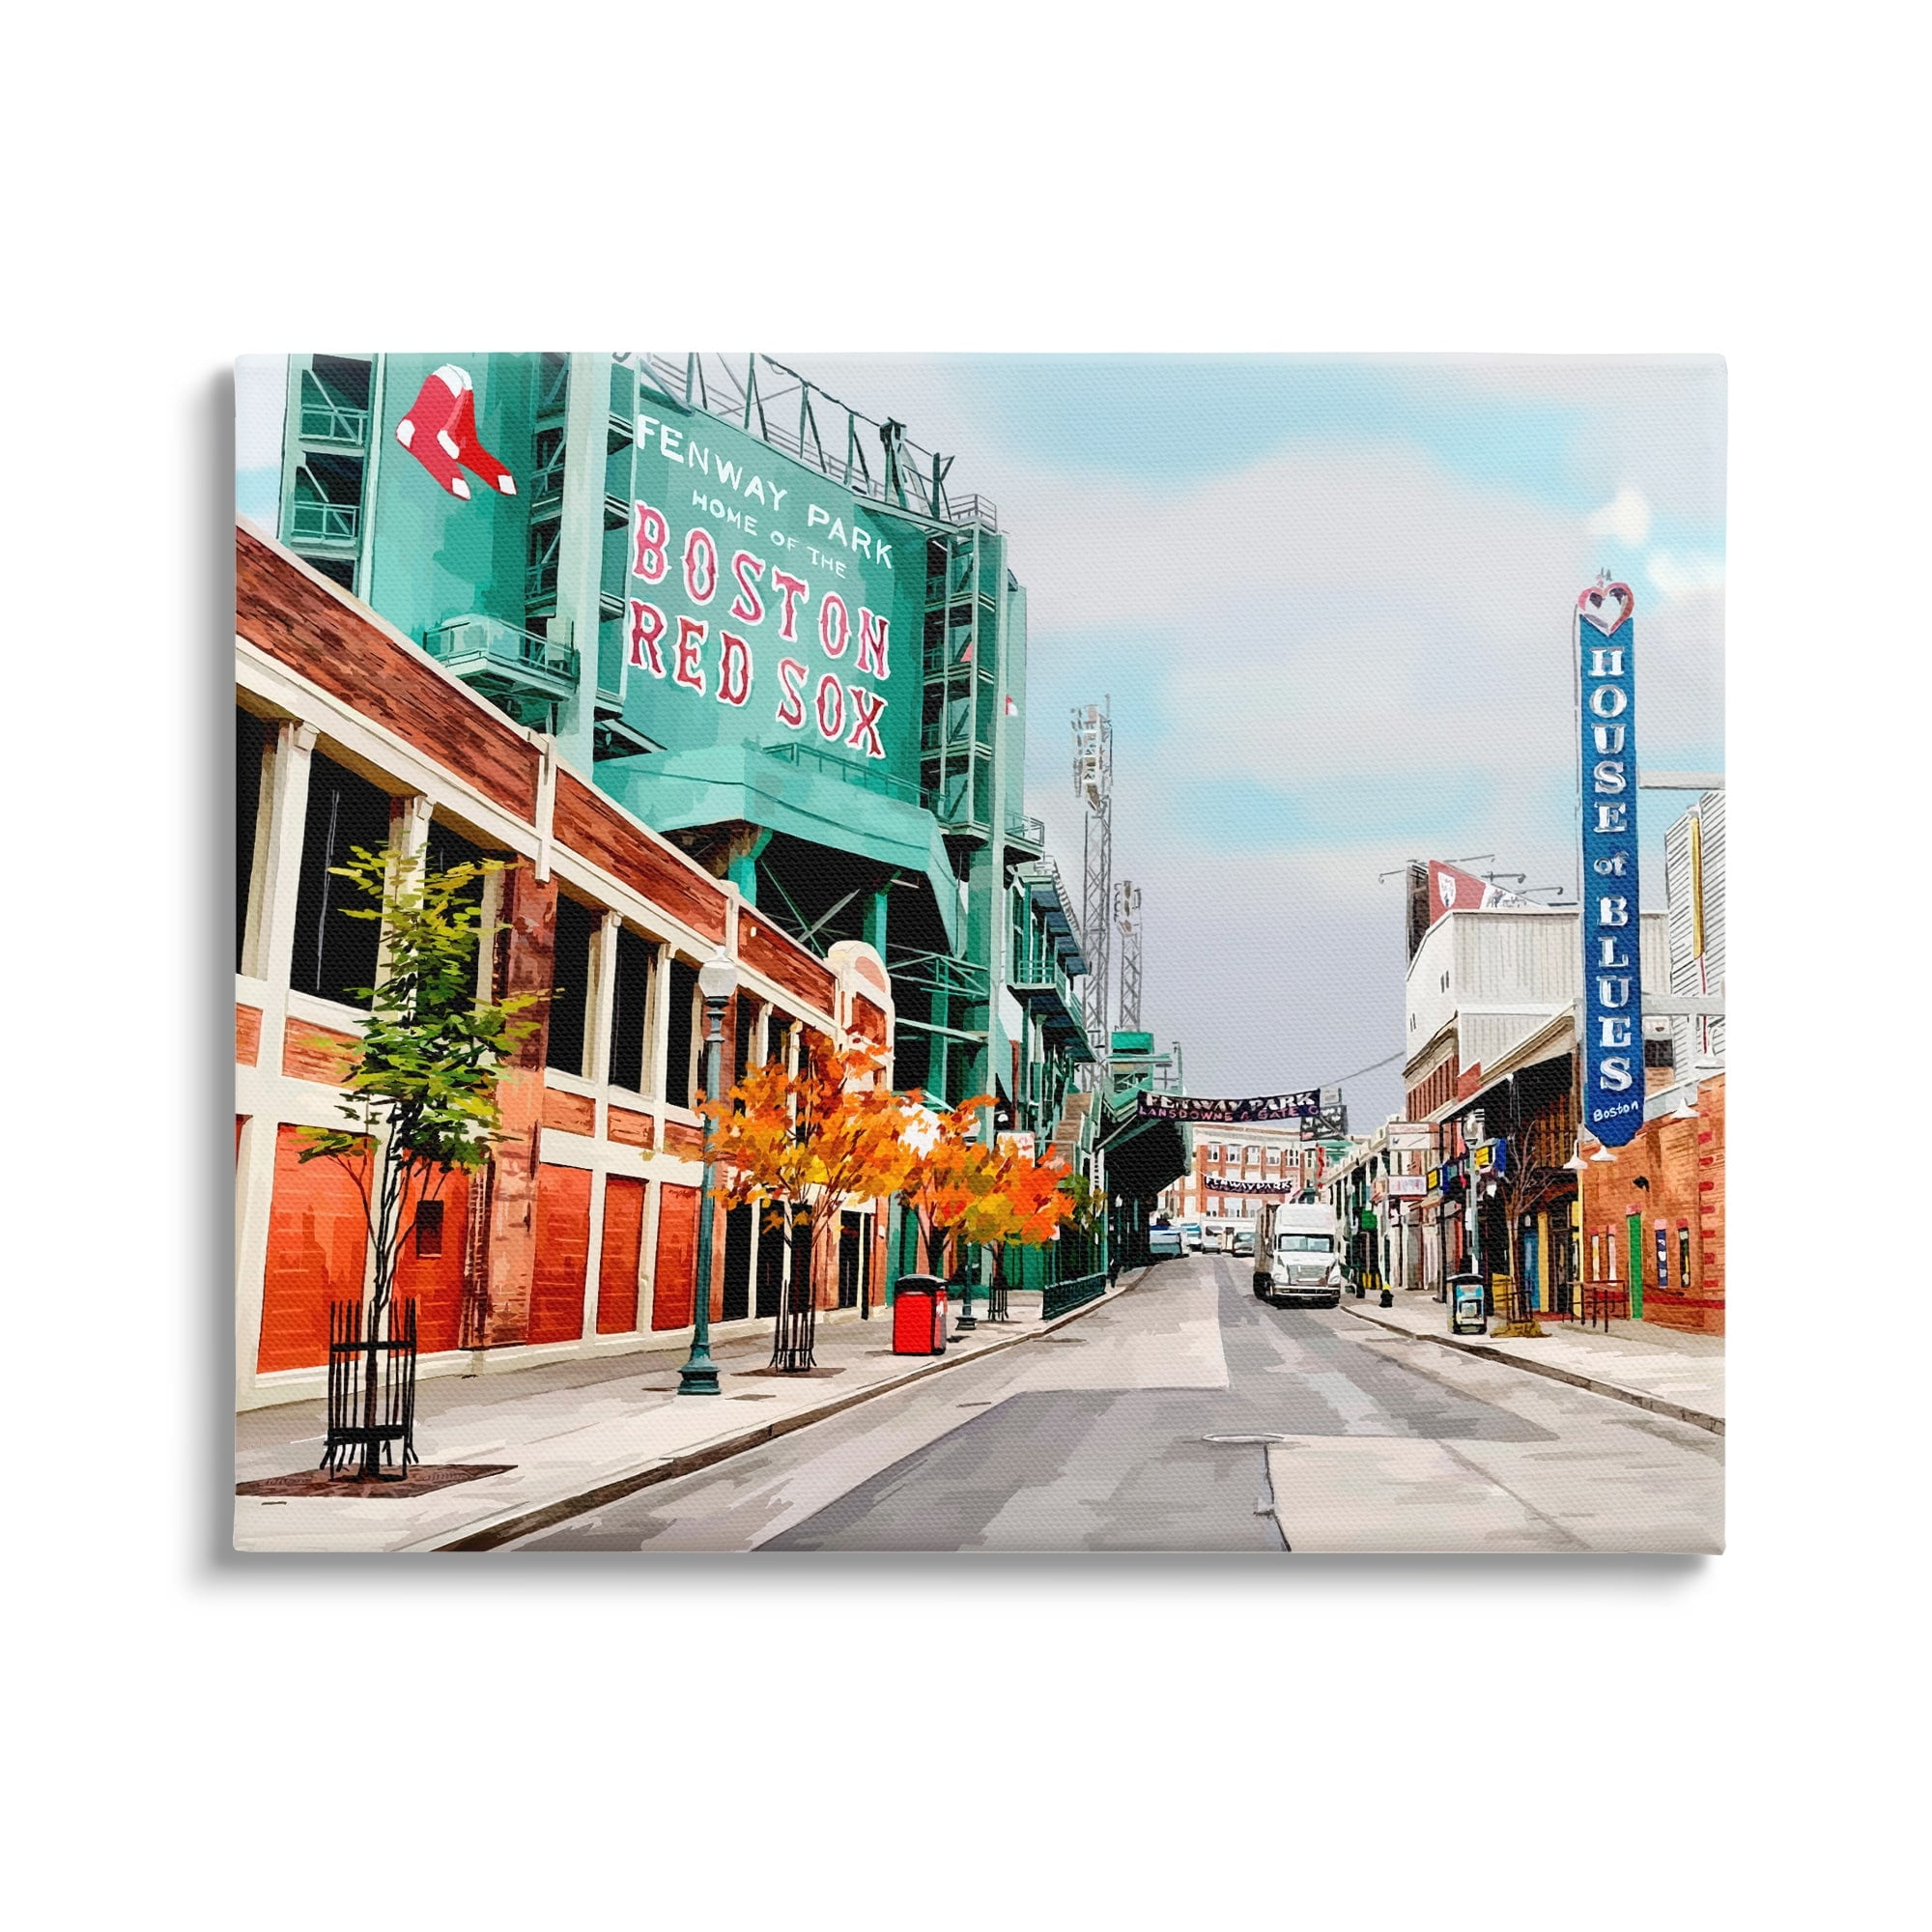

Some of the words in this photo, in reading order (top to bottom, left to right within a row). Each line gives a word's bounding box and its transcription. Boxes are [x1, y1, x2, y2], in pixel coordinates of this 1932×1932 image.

[638, 413, 787, 511] FENWAY
[808, 504, 893, 569] PARK
[692, 490, 758, 536] HOME
[770, 530, 800, 552] OF
[807, 546, 847, 580] THE
[632, 499, 892, 680] BOSTON
[628, 597, 753, 706] RED
[776, 657, 888, 759] SOX
[1588, 646, 1628, 834] HOUSE
[1594, 851, 1630, 876] of
[1596, 896, 1633, 1092] BLUES
[1139, 1105, 1234, 1121] LANSDOWNE
[1258, 1103, 1299, 1121] GATE
[1146, 1093, 1242, 1112] FENWAY
[1249, 1093, 1315, 1111] PARK
[1593, 1100, 1639, 1122] Boston
